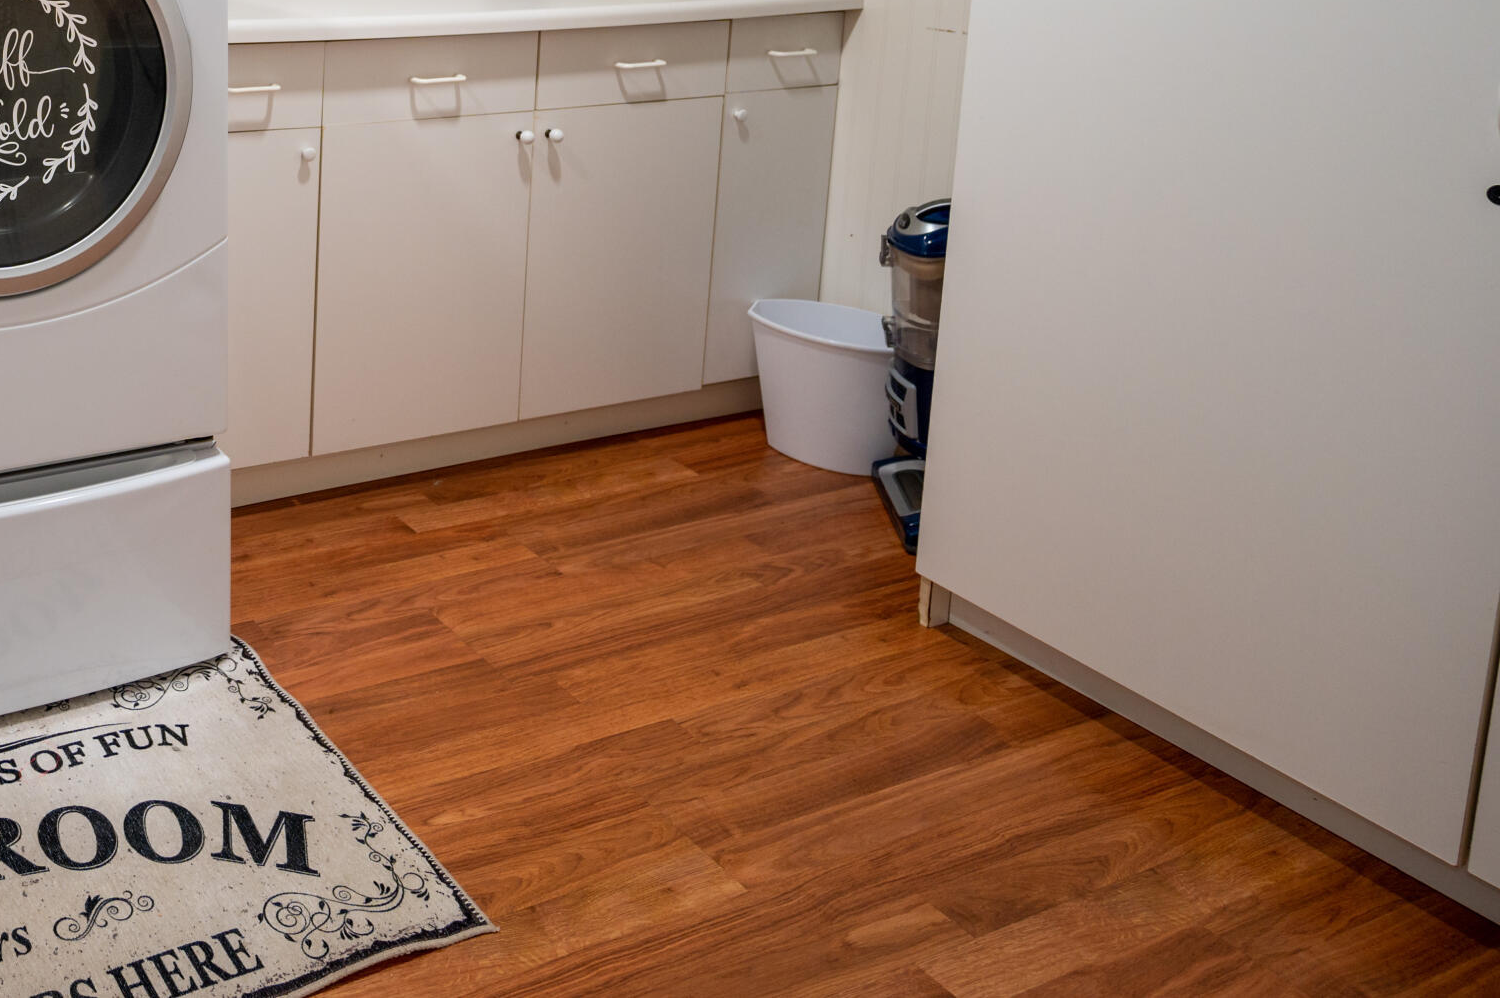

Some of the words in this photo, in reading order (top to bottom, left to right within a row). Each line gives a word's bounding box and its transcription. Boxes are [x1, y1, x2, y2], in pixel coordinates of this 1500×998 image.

[31, 739, 88, 775] OF
[94, 722, 191, 758] FUN
[106, 927, 264, 998] HERE
